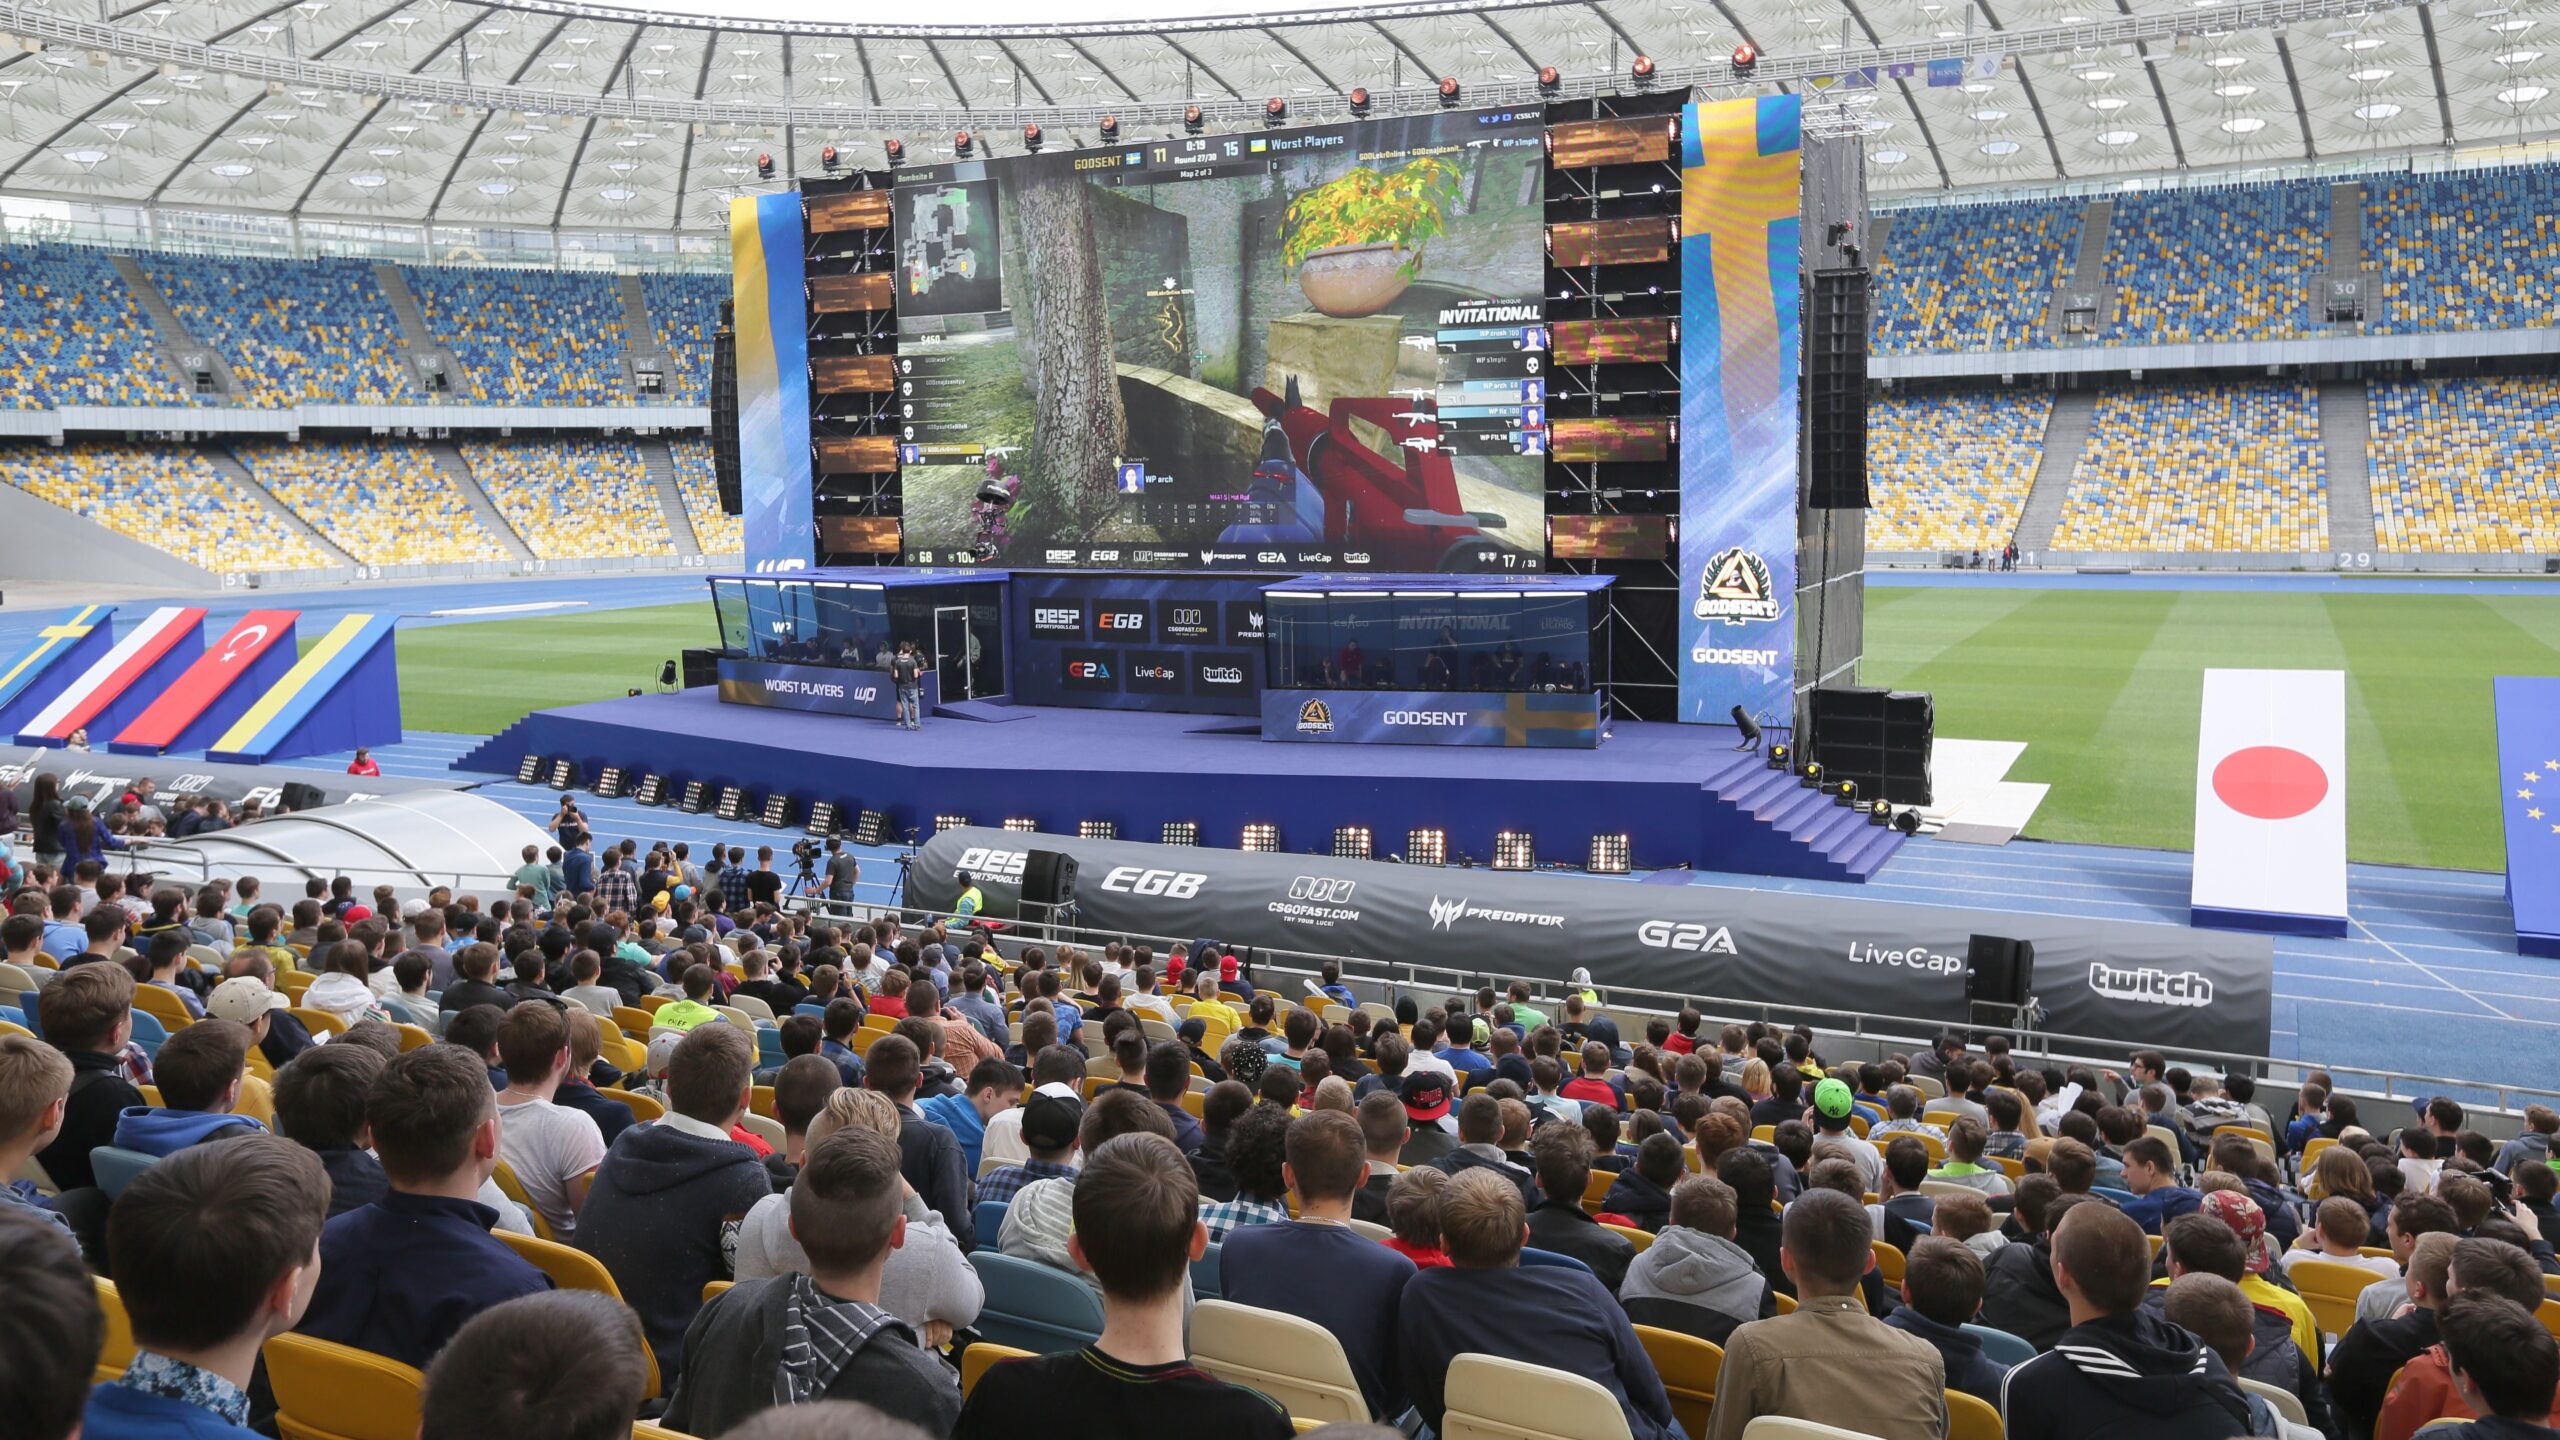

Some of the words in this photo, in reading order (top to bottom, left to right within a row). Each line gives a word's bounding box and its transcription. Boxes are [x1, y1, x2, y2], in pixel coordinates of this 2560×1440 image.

[1186, 140, 1206, 151] 0:19
[1223, 141, 1239, 156] 15
[1271, 138, 1303, 150] Worst
[1304, 135, 1344, 149] Players
[1502, 139, 1513, 147] WP
[1074, 155, 1121, 170] GODSENT
[1153, 148, 1167, 163] 11
[1174, 155, 1196, 164] Round
[1197, 153, 1217, 163] 27/30
[897, 173, 927, 182] Bombsite
[1180, 170, 1194, 178] Map
[2334, 283, 2356, 295] 30
[2074, 297, 2092, 308] 32
[1438, 305, 1541, 325] INVITATIONAL
[920, 334, 941, 346] $450
[183, 356, 202, 368] 50
[420, 358, 437, 368] 48
[638, 361, 655, 370] 46
[1145, 475, 1157, 483] WP
[1157, 475, 1174, 483] arch
[683, 555, 705, 567] 45
[919, 551, 933, 563] 68
[1090, 550, 1120, 561] EGB
[1257, 552, 1287, 563] G2A
[1298, 553, 1332, 564] LiveCap
[1343, 552, 1371, 564] twitch
[1502, 554, 1516, 568] 17
[1527, 559, 1537, 568] 33
[2340, 552, 2370, 567] 29
[356, 566, 381, 580] 49
[522, 560, 546, 572] 47
[225, 572, 249, 586] 51
[1696, 600, 1777, 618] GODSENT
[1099, 613, 1144, 629] EGB
[1398, 614, 1511, 631] INVITATIONAL
[1692, 648, 1778, 666] GODSENT
[1069, 661, 1110, 679] G2A
[1135, 666, 1175, 680] LiveCap
[1203, 666, 1242, 683] twitch
[765, 679, 800, 694] WORST
[801, 683, 844, 698] PLAYERS
[1383, 711, 1468, 726] GODSENT
[1296, 721, 1334, 732] GODSENT
[1100, 866, 1208, 899] EGB
[1268, 902, 1360, 921] CSGOFAST.COM
[1465, 907, 1567, 929] PREDATOR
[1637, 919, 1738, 954] G2A
[1848, 941, 1962, 976] LiveCap
[2088, 961, 2214, 1008] twitch
